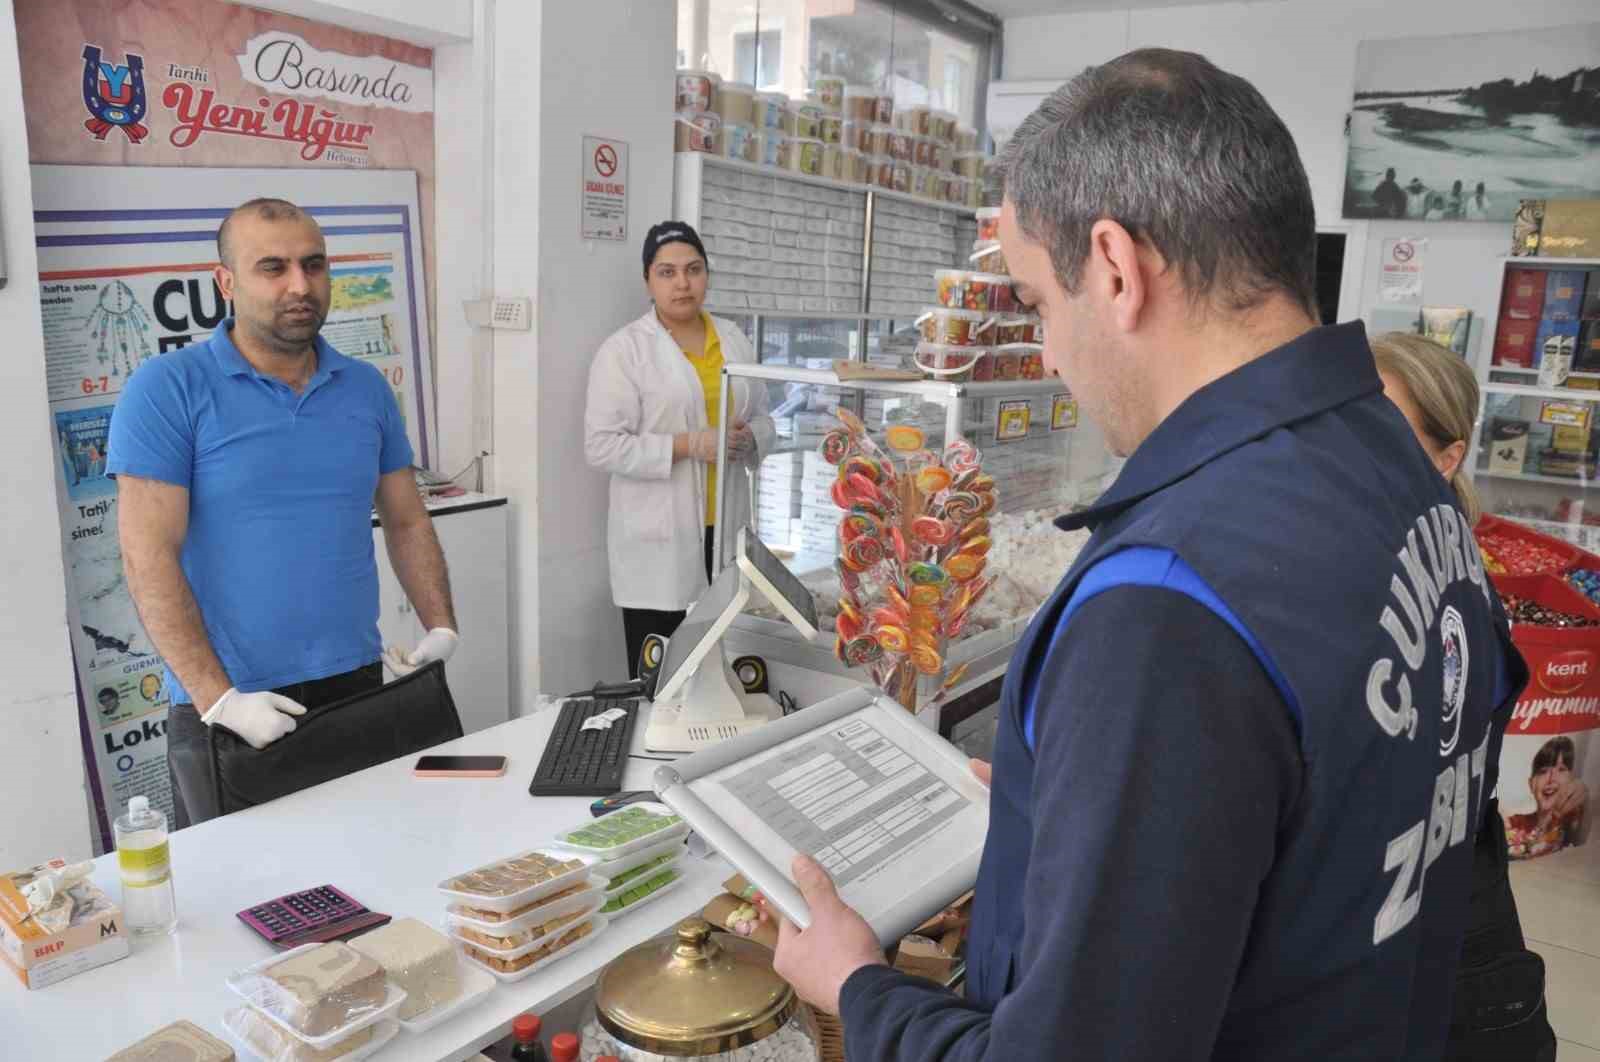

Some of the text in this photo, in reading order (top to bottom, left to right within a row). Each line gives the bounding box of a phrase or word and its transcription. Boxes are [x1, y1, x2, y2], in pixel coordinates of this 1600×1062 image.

[167, 63, 209, 83] Tarihi
[255, 40, 412, 104] Basında
[162, 81, 373, 161] Yeni Uğur
[153, 278, 234, 333] CU
[365, 340, 382, 354] 11
[81, 376, 109, 394] 6-7
[1366, 503, 1492, 741] ÇUKURO
[1546, 660, 1588, 676] kent
[100, 919, 118, 937] M
